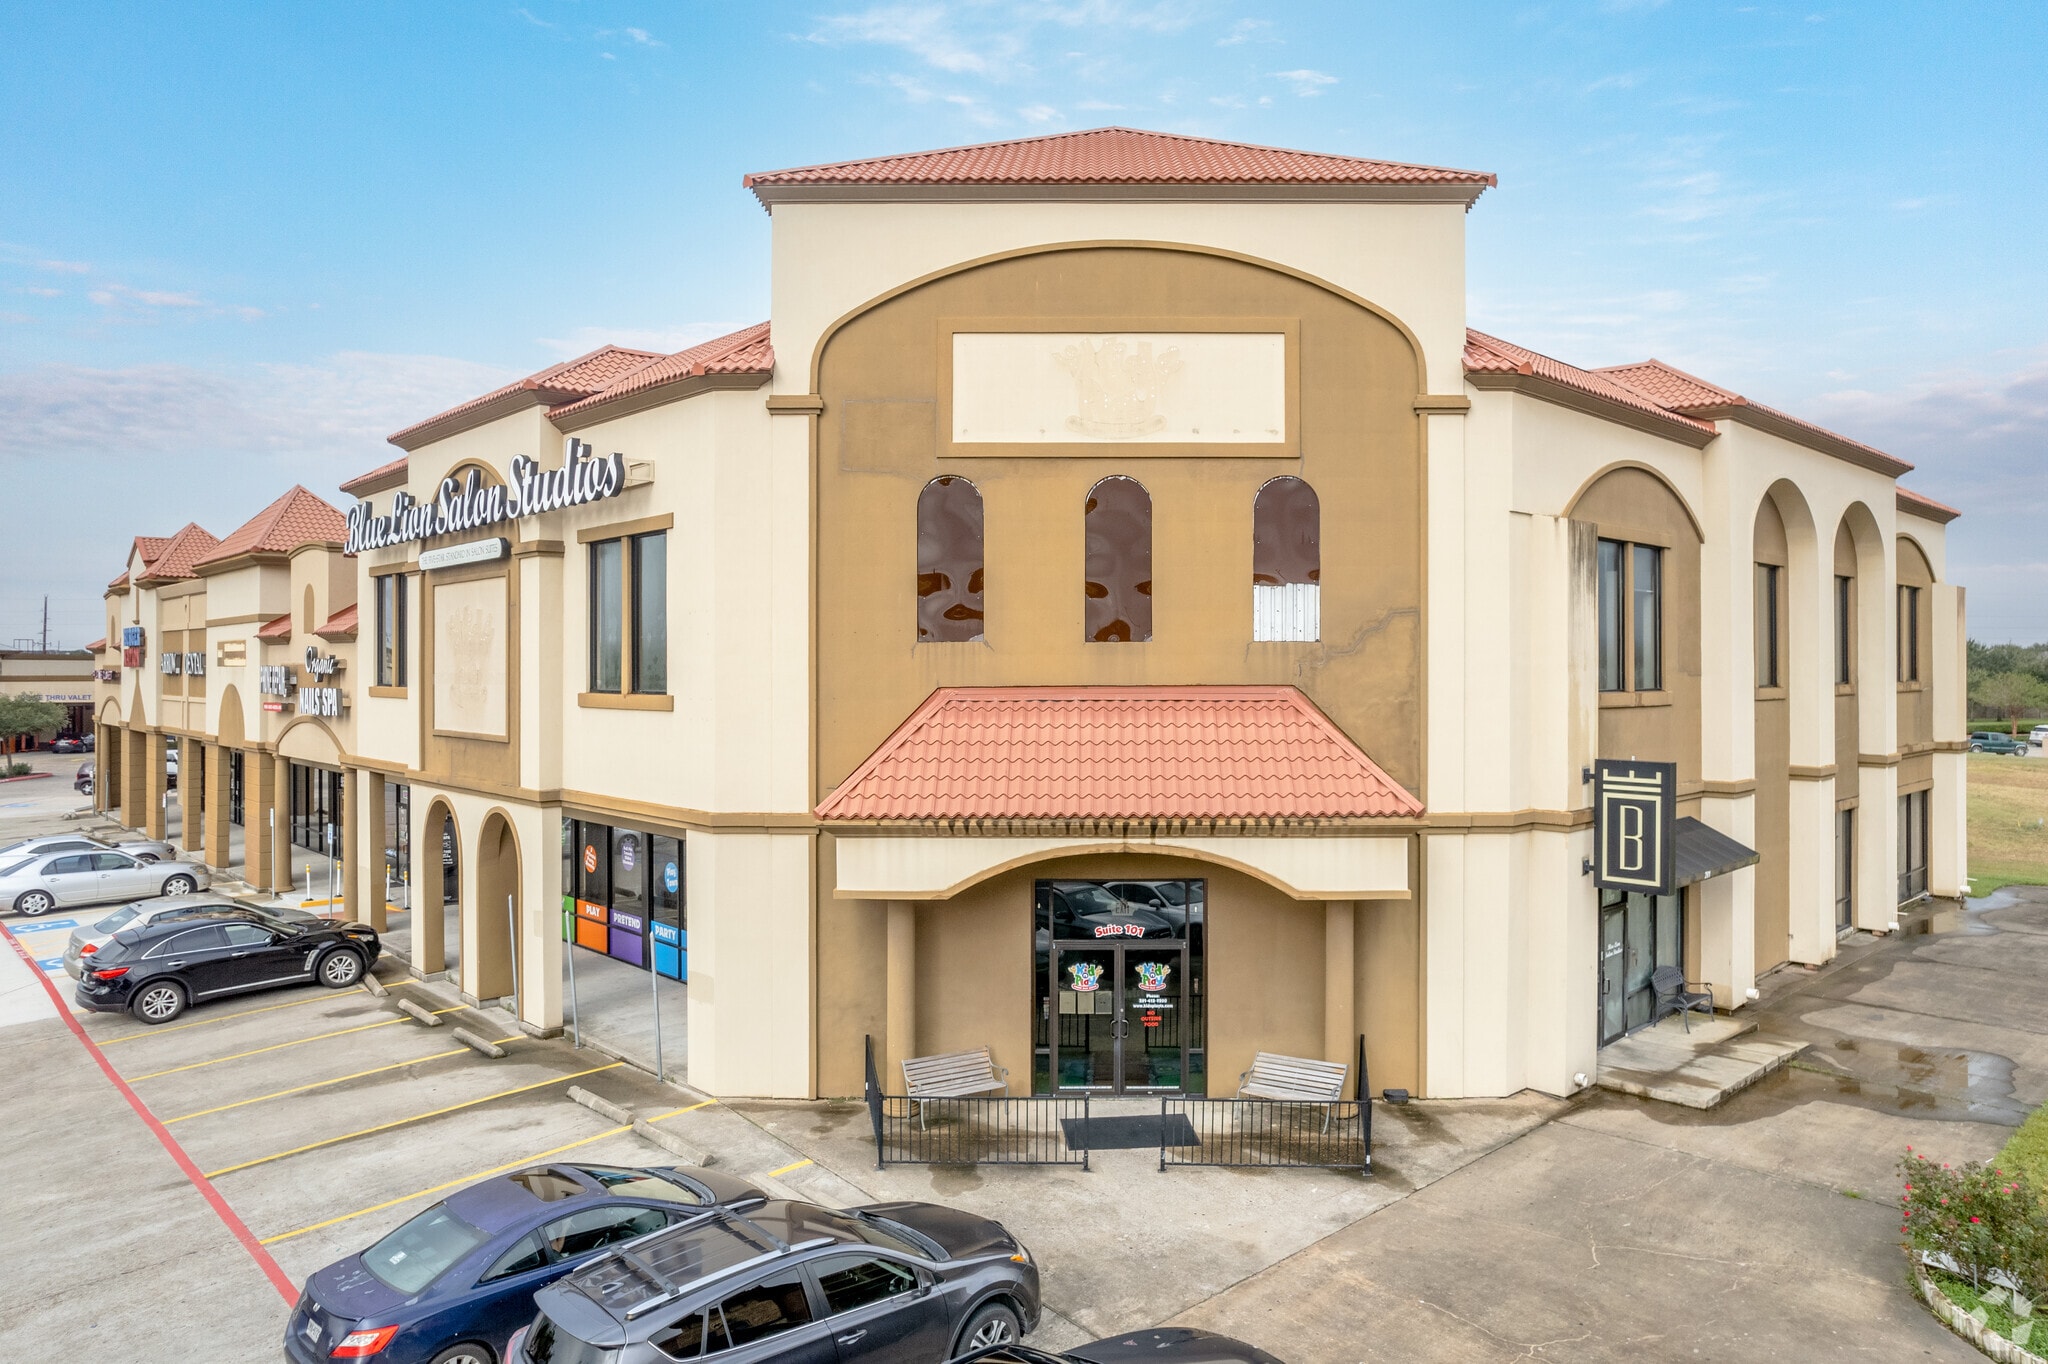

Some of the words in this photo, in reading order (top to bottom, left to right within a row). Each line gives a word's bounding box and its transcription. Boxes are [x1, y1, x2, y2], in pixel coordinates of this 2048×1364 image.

[344, 501, 389, 554] Blue
[387, 491, 435, 546] Lion
[435, 468, 506, 535] Salon
[506, 437, 620, 519] Studios
[471, 545, 485, 556] SALON
[305, 646, 335, 683] Organic
[299, 687, 320, 716] NAILS
[322, 687, 338, 717] SPA
[1619, 805, 1644, 871] B
[585, 904, 600, 917] PLAY
[613, 912, 641, 929] PRETEND
[654, 925, 677, 940] PARTY
[1094, 924, 1123, 938] Suite
[1125, 923, 1145, 938] 101
[1075, 962, 1096, 976] Kid
[1142, 962, 1163, 976] Kid
[1075, 974, 1097, 987] Play
[1142, 974, 1164, 987] Play
